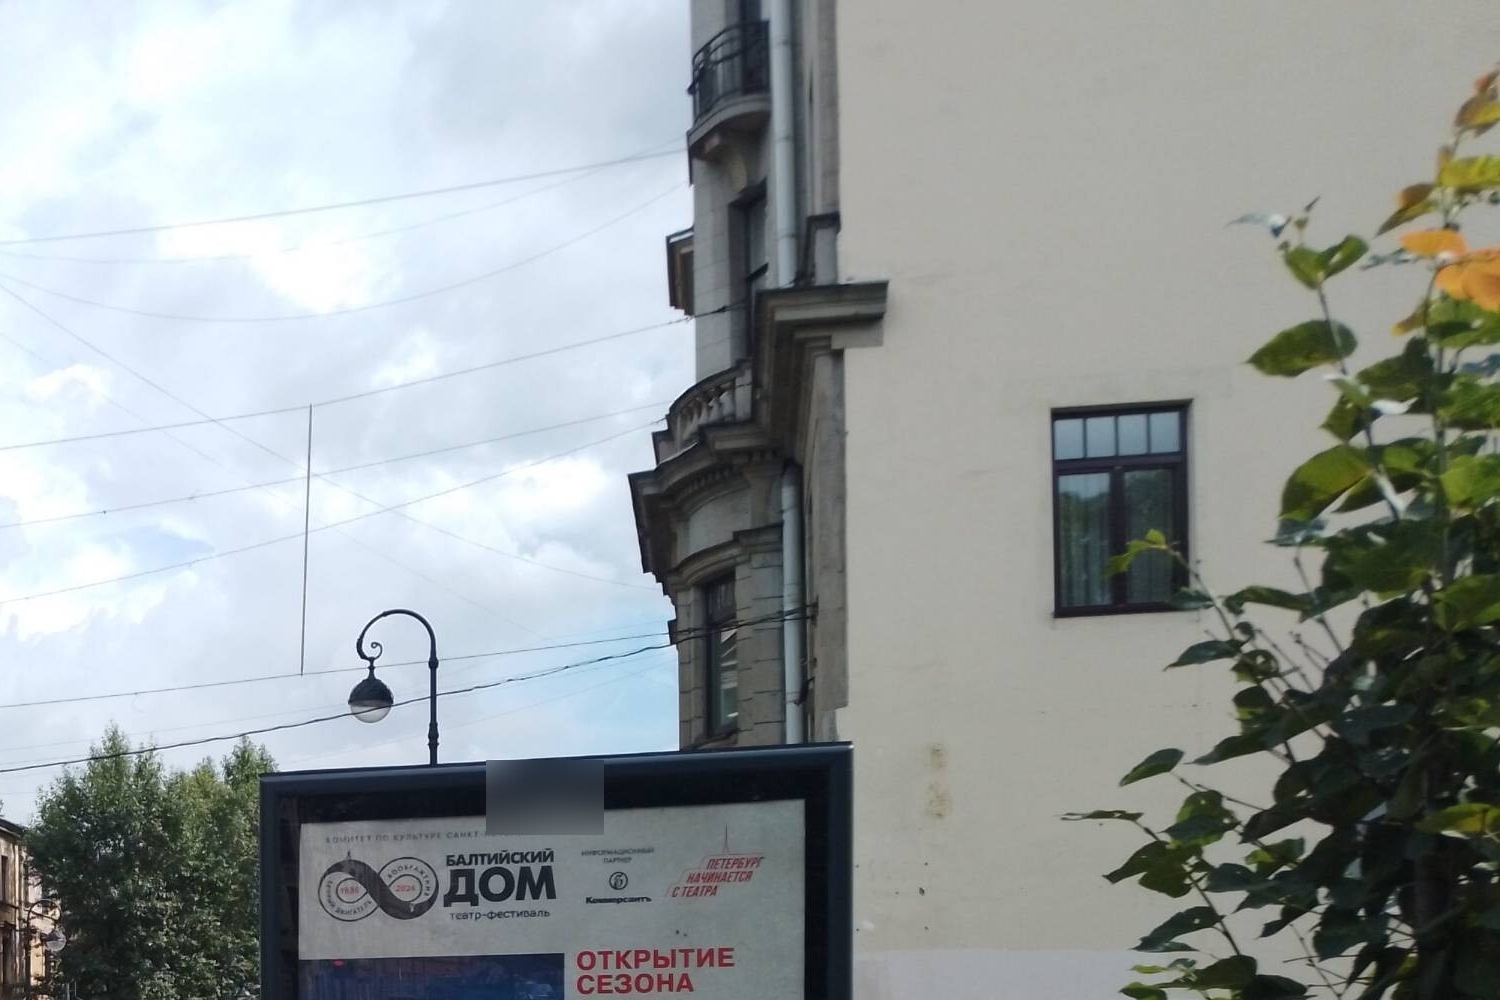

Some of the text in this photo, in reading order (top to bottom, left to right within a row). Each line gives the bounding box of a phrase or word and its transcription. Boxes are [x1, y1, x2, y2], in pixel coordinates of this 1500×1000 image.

[445, 848, 554, 866] БАЛТИЙСКИЙ
[706, 856, 765, 870] ПЕТЕРБУРГ
[686, 870, 753, 884] НАЧИНАЕТСЯ
[443, 866, 557, 907] ДОМ
[671, 885, 719, 898] С ТЕАТРА
[450, 909, 550, 921] театр-фестиваль
[576, 948, 735, 971] ОТКРЫТИЕ
[576, 973, 694, 995] СЕЗОНА
